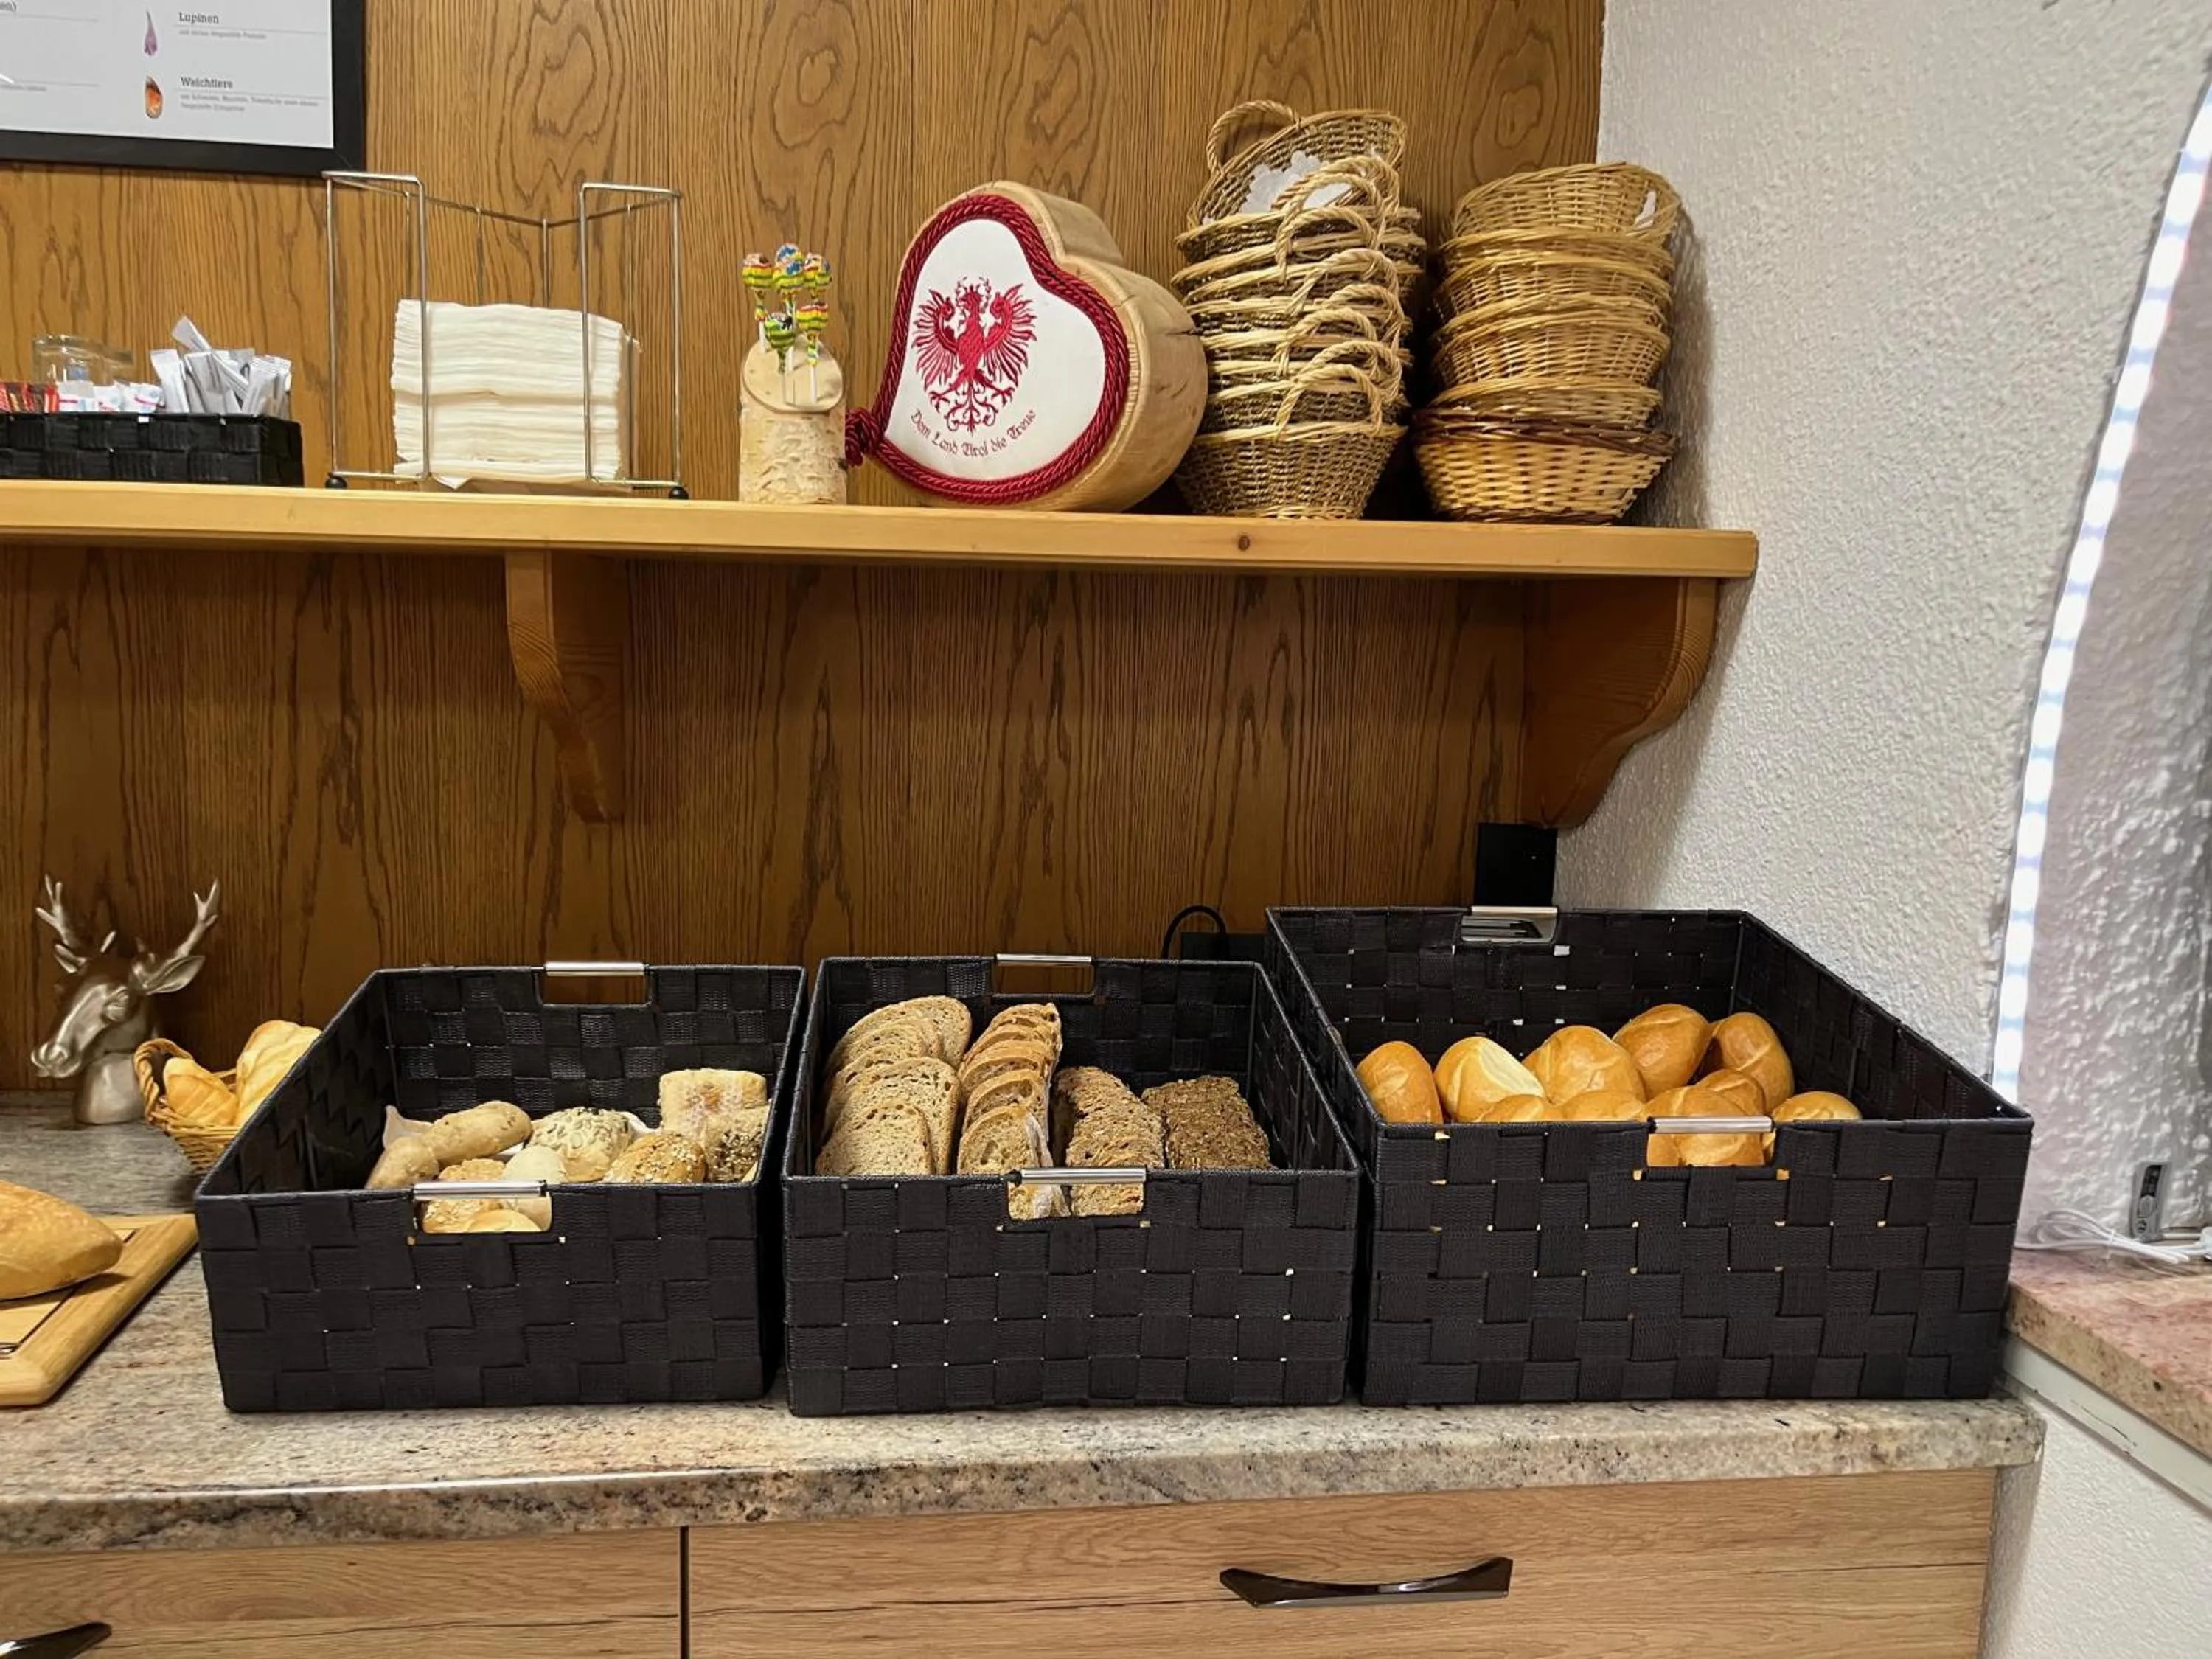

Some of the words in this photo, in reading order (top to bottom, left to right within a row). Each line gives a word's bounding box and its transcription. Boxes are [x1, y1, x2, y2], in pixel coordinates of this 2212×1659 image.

[179, 12, 219, 26] Lupinen
[181, 77, 233, 89] Weichtiere
[961, 442, 989, 457] Tirol
